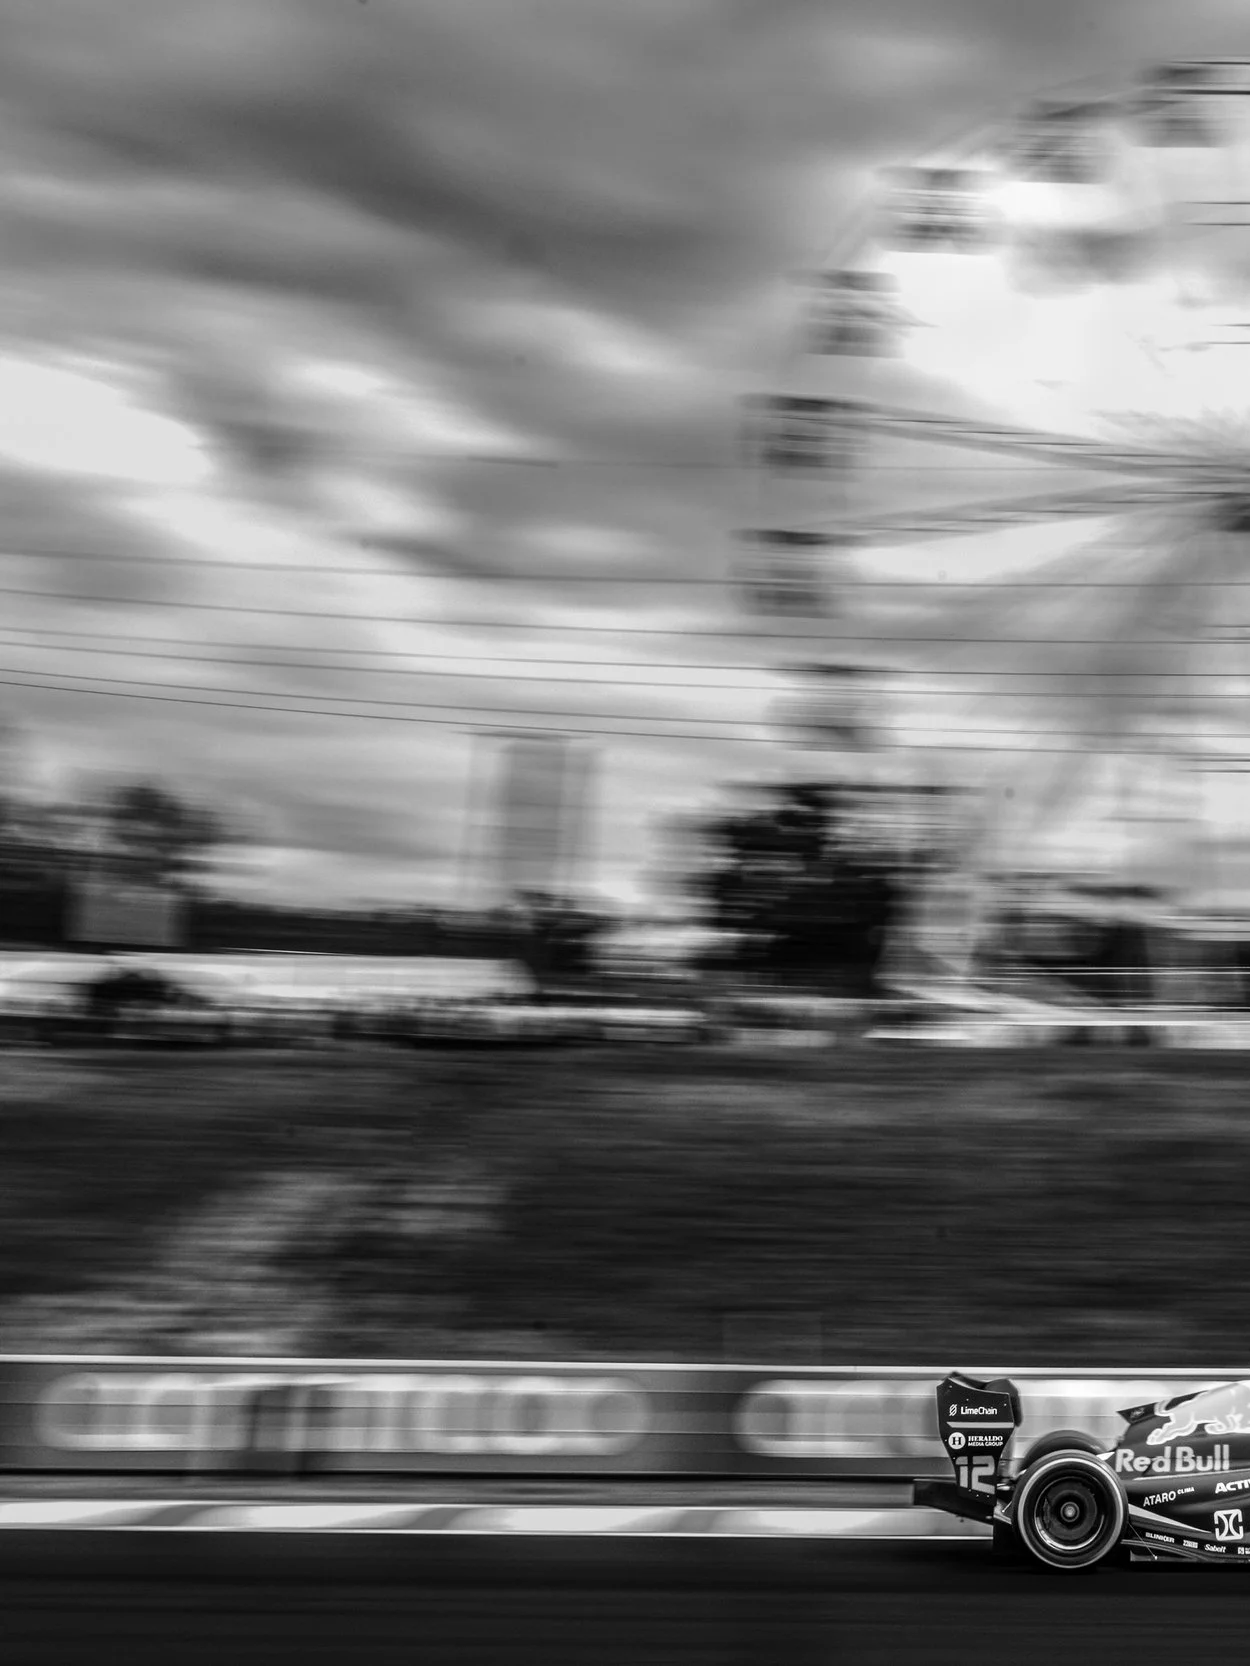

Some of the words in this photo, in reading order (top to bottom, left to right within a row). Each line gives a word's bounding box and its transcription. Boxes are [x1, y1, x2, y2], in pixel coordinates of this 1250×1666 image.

[961, 1406, 998, 1415] LimeChain
[1115, 1446, 1172, 1473] Red
[1175, 1444, 1230, 1472] Bull
[955, 1455, 995, 1495] 12
[1143, 1491, 1176, 1507] ATARO
[1177, 1487, 1195, 1495] CLIMA
